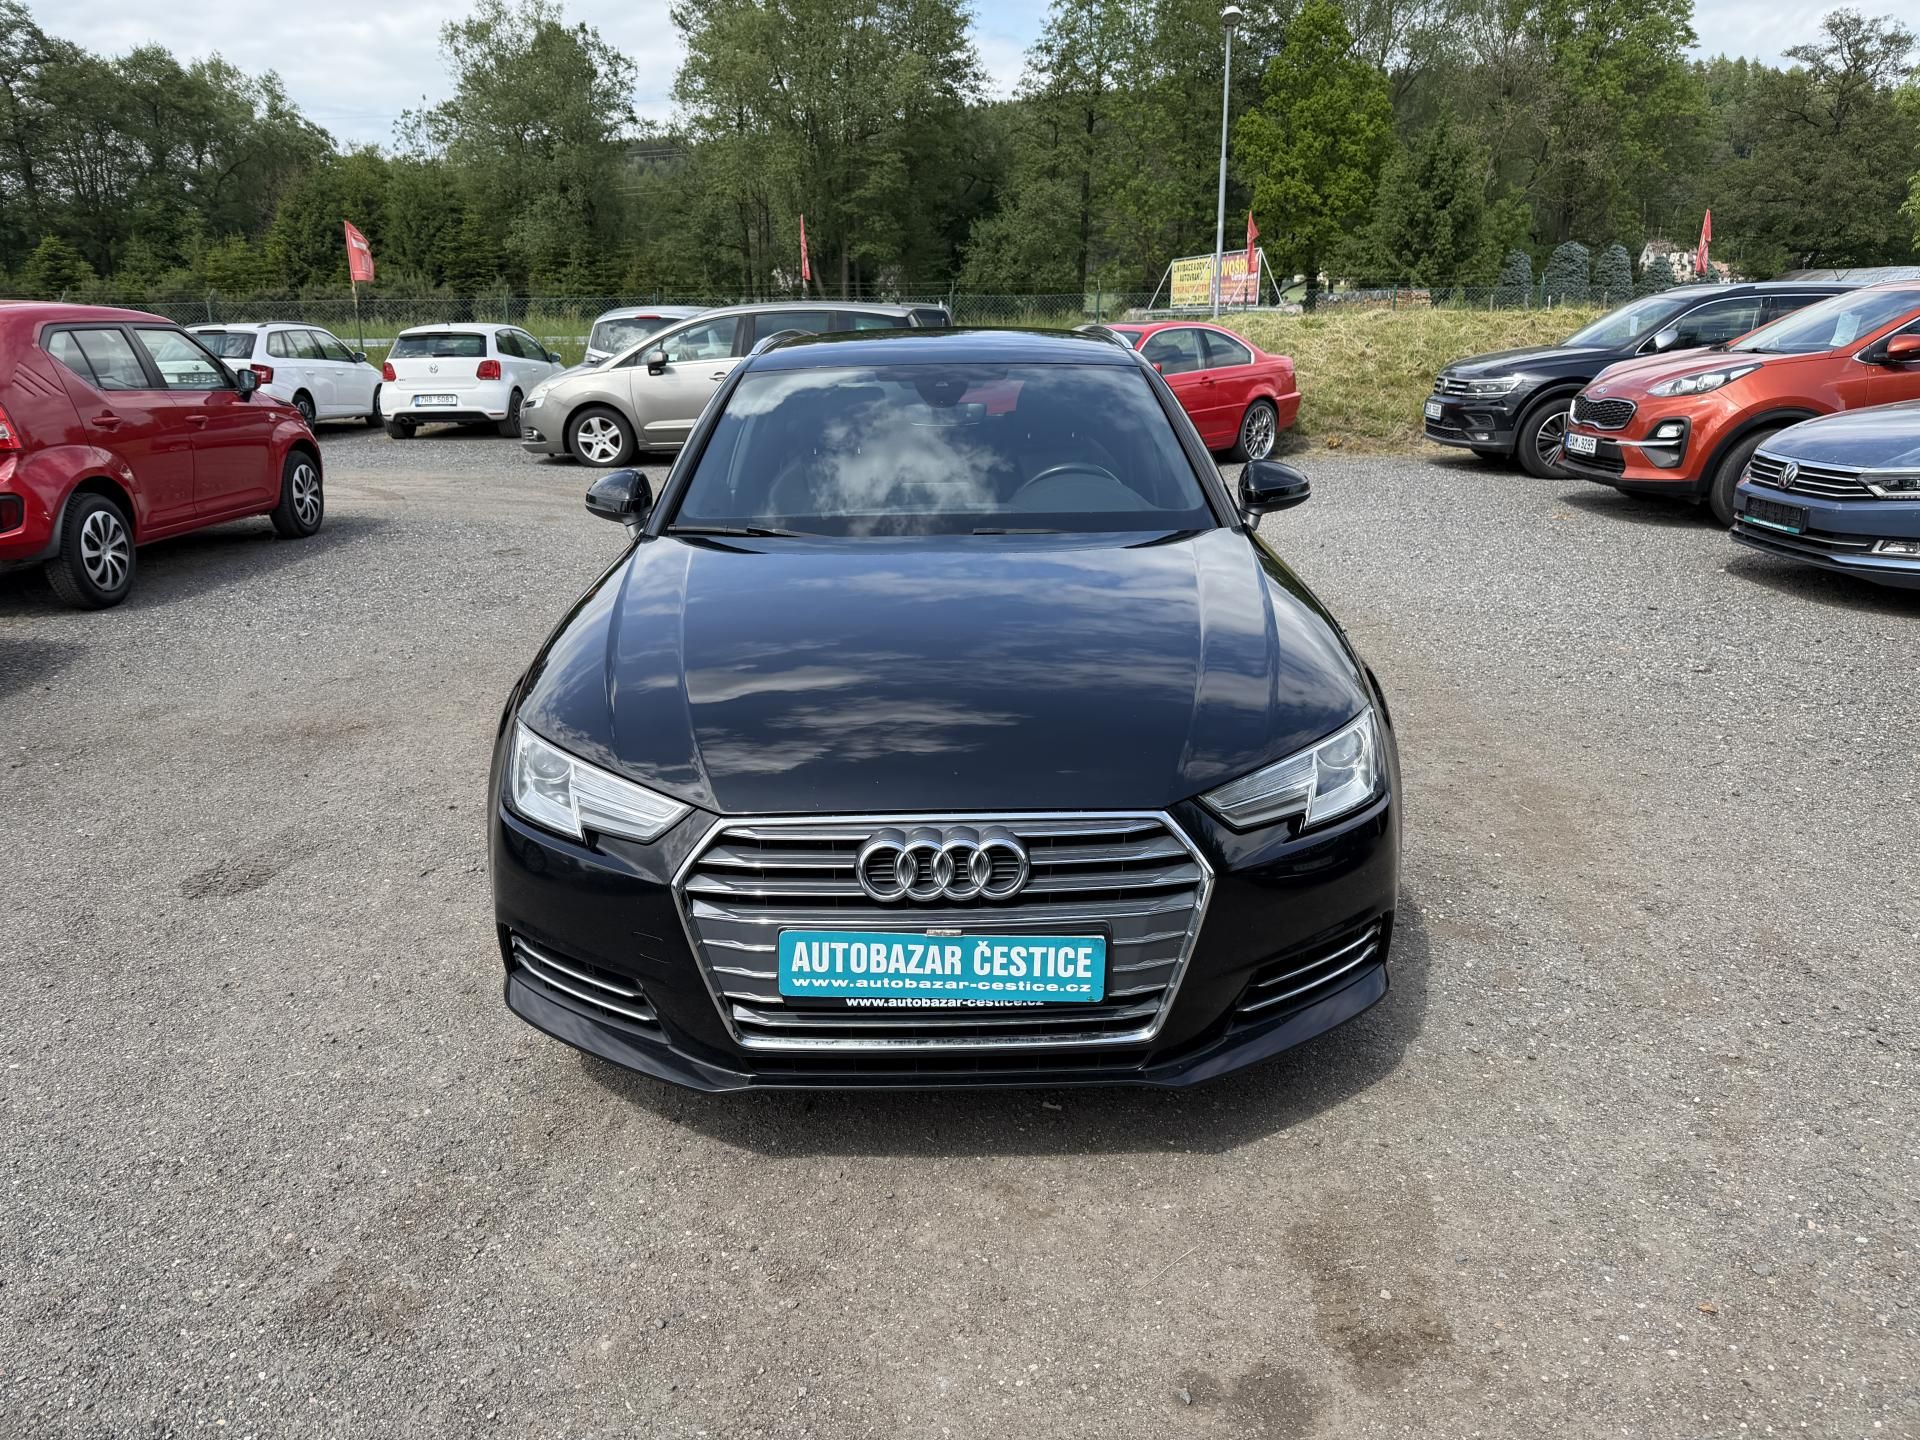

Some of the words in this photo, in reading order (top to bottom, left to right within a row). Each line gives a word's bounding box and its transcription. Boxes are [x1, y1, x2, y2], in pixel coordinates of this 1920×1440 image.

[1580, 437, 1594, 451] 9295
[791, 941, 962, 975] AUTOBAZAR
[973, 940, 1092, 978] ČESTICE
[792, 977, 1091, 993] www.autobazar-cestice.cz
